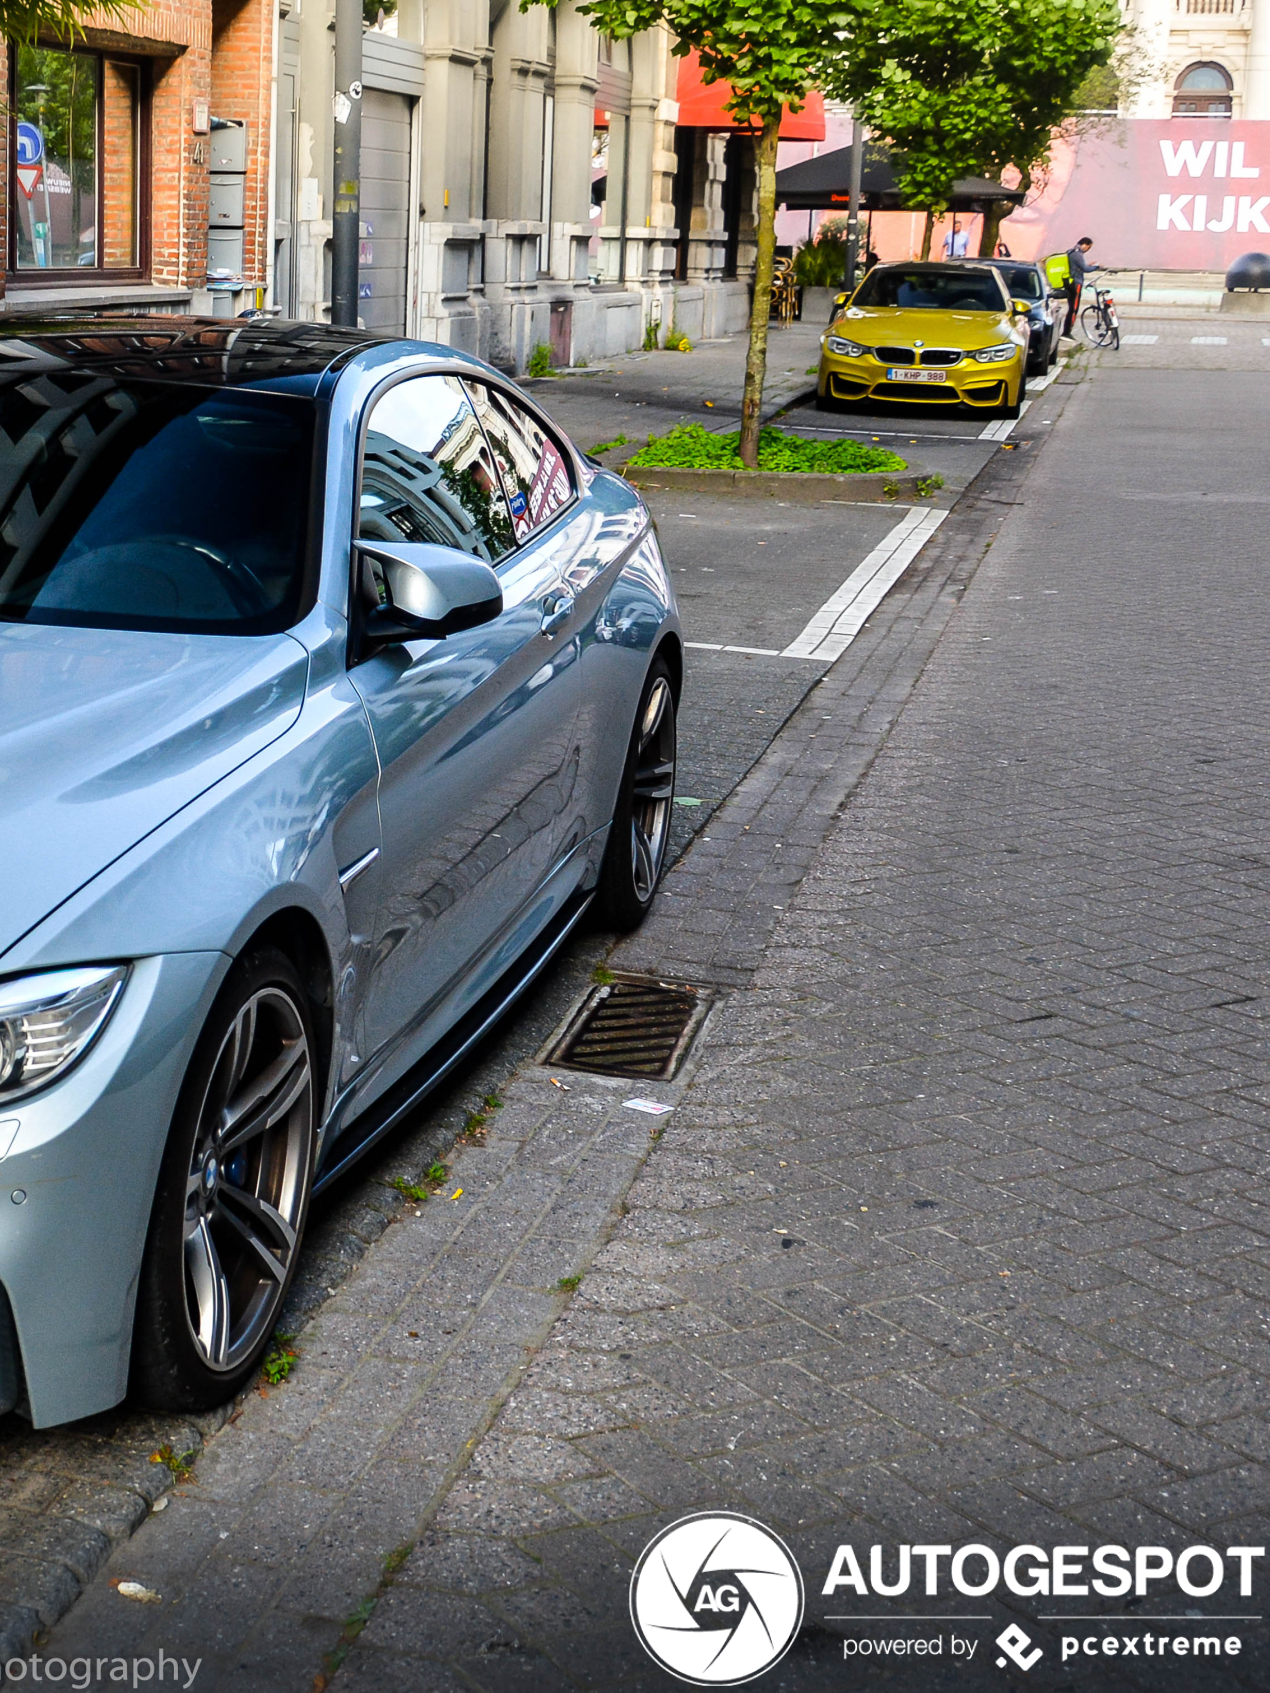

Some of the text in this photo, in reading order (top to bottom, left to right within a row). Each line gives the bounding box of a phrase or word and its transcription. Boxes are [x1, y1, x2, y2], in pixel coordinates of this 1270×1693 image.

[1158, 140, 1260, 178] WIL
[1156, 193, 1270, 233] KIJK
[894, 370, 944, 381] 1-KHP-988
